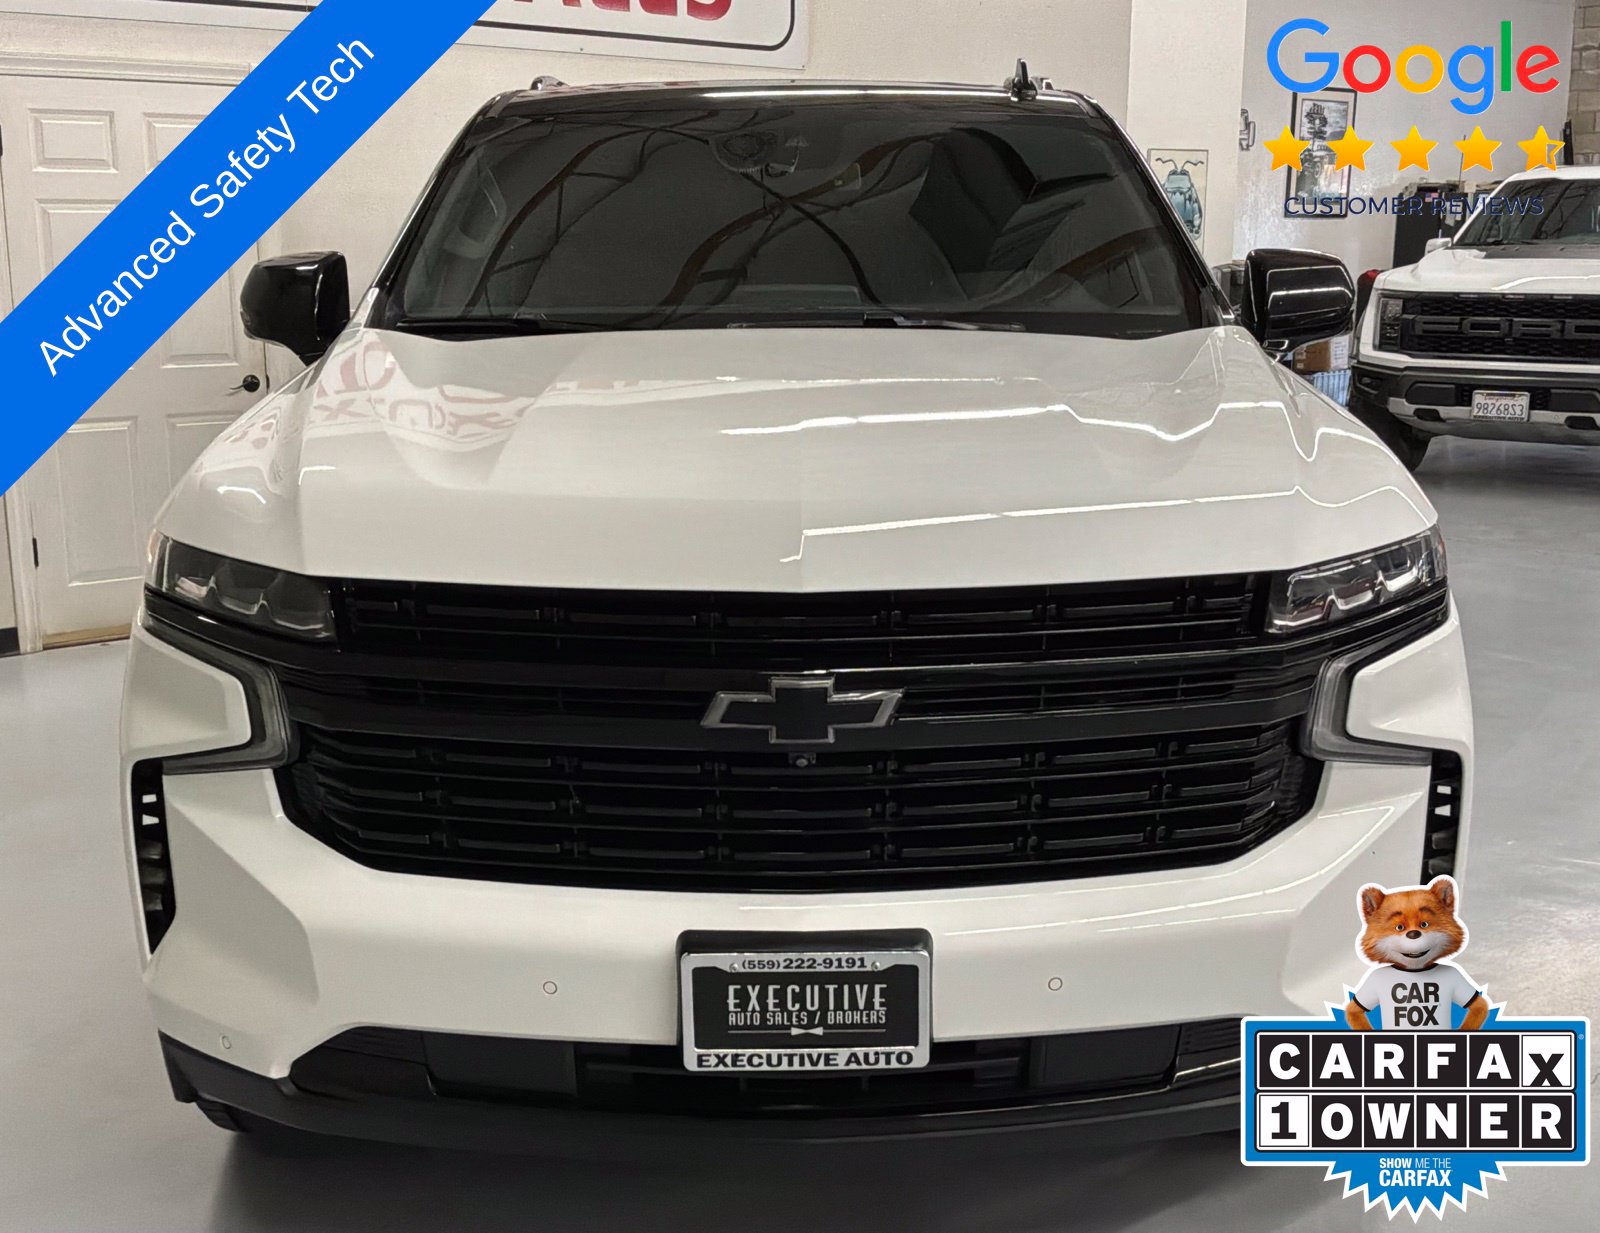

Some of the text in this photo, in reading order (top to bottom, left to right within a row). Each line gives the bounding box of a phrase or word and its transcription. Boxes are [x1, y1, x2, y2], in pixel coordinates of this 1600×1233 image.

[727, 983, 888, 1012] EXECUTIVE
[728, 1011, 761, 1026] AUTO
[766, 1011, 808, 1026] SALES
[827, 1010, 886, 1025] BROKERS
[696, 1051, 914, 1068] EXECUTIVE AUTO
